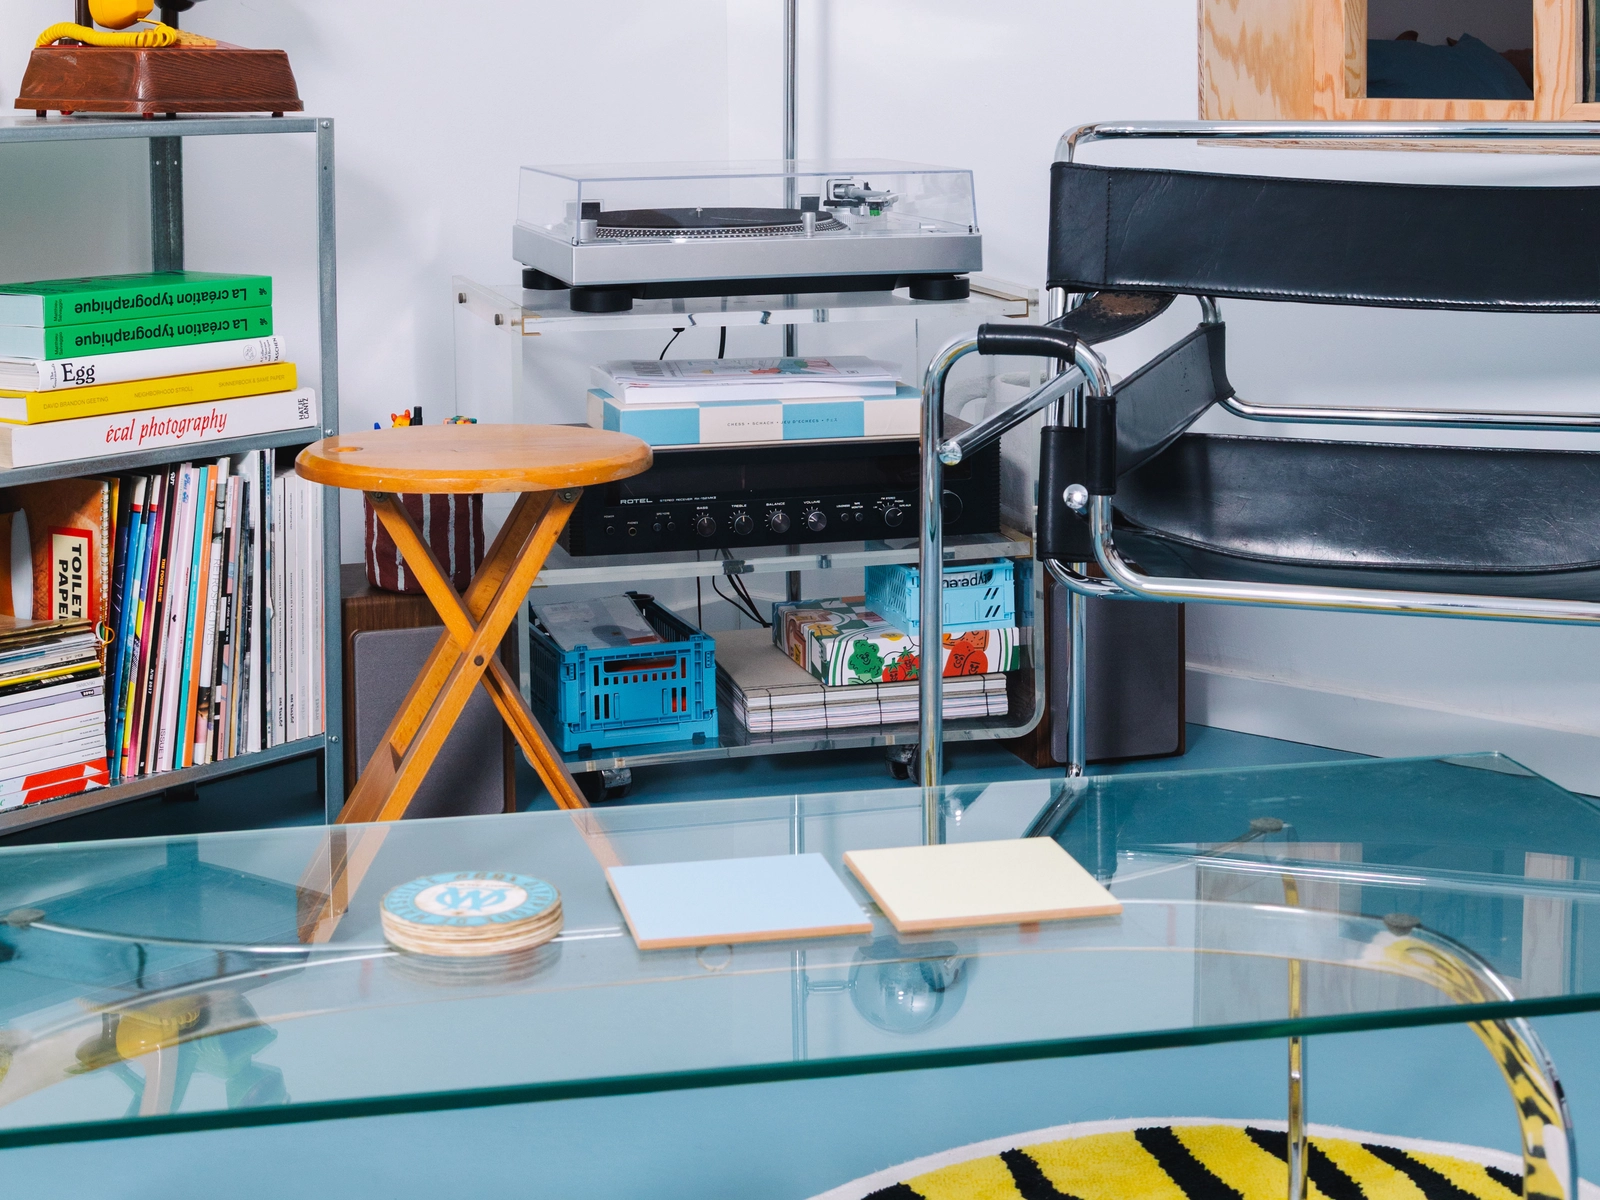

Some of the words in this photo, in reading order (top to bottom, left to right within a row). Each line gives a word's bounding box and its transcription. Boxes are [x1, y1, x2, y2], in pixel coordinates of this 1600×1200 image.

[74, 292, 174, 314] typographique
[176, 289, 229, 302] création
[233, 288, 247, 301] La
[75, 324, 174, 347] typographique
[177, 320, 230, 334] création
[233, 319, 248, 331] La
[61, 362, 96, 385] Egg
[134, 388, 174, 398] NEIGHBORHOOD
[105, 418, 136, 444] écal
[139, 408, 228, 446] photography
[58, 559, 68, 620] PAPE
[72, 543, 82, 620] TOILET
[207, 558, 220, 646] RETROSPECTIVES
